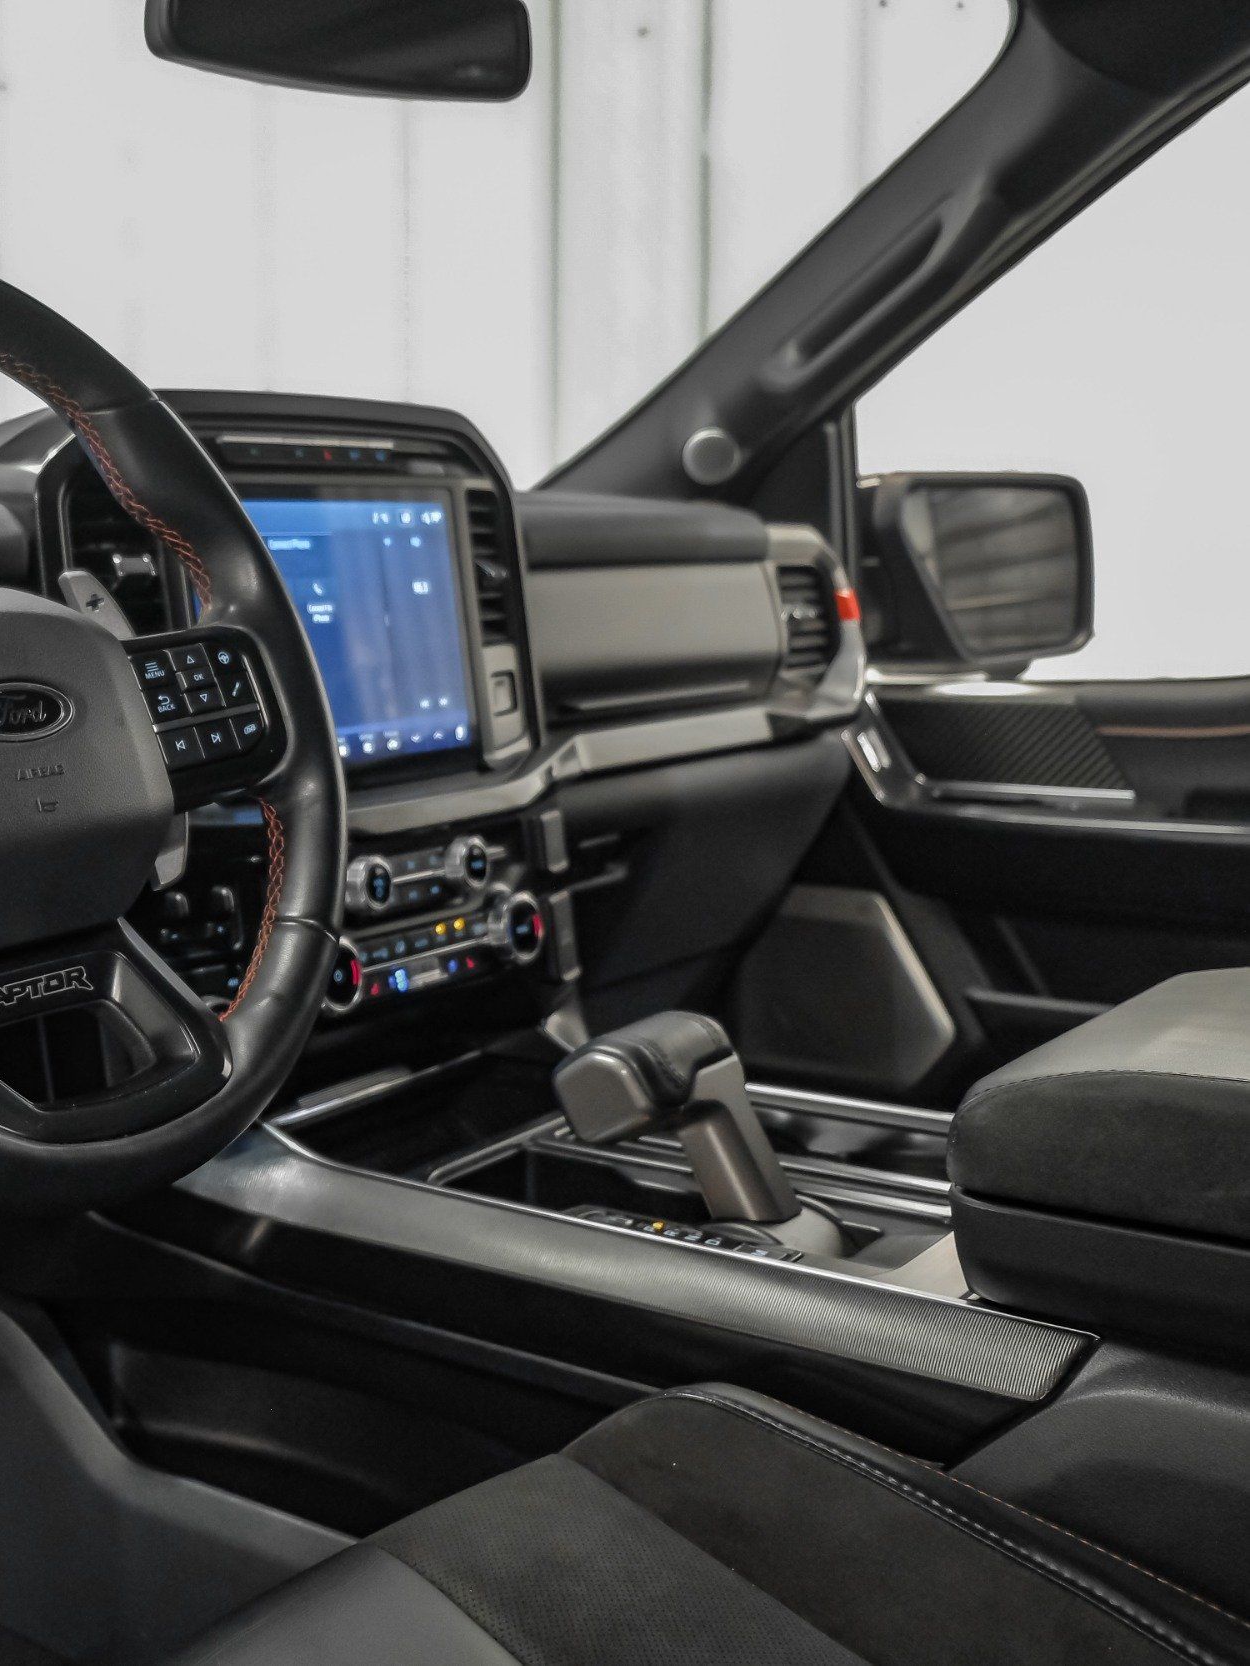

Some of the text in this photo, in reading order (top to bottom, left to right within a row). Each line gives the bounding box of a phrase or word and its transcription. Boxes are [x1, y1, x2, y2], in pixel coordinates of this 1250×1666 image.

[145, 670, 165, 680] MENU
[193, 673, 204, 681] OK
[157, 704, 175, 713] BACK
